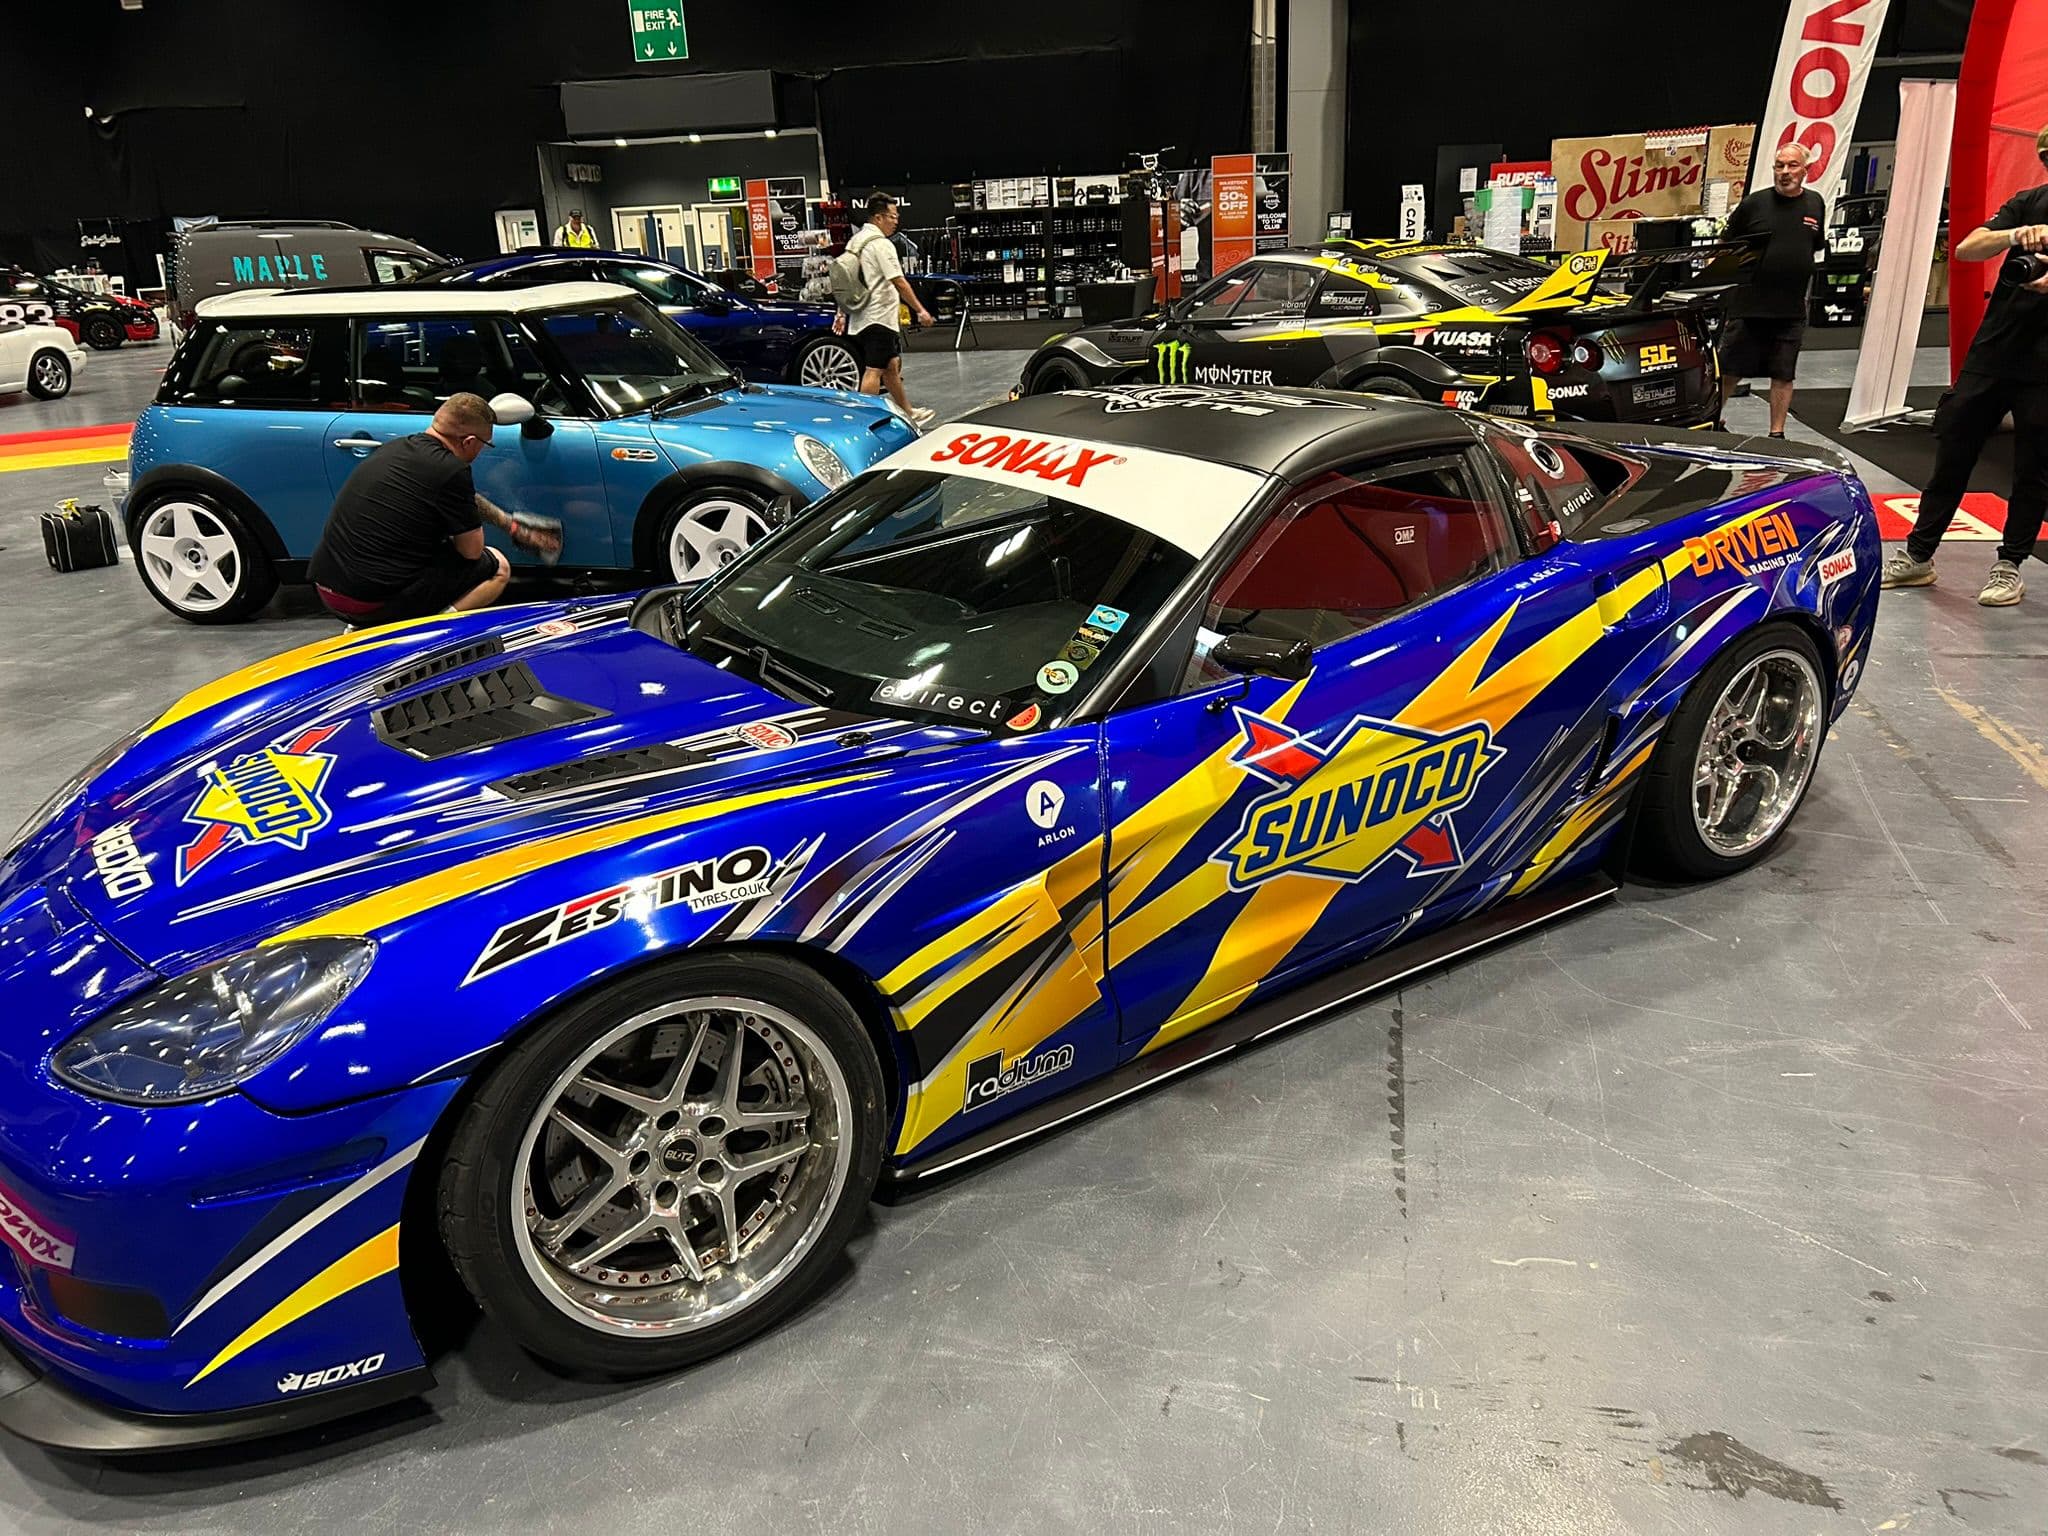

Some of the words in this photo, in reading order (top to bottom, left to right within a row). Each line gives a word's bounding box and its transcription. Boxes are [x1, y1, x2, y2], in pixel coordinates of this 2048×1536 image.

[644, 9, 665, 20] FIRE
[645, 20, 666, 31] EXIT
[1219, 191, 1248, 201] 50%
[1564, 148, 1702, 222] Slim's
[752, 213, 767, 222] 50%
[1219, 201, 1248, 211] OFF
[752, 222, 768, 231] OFF
[1406, 208, 1416, 239] CAR
[775, 233, 799, 241] WELCO
[233, 254, 328, 284] MAPLE
[0, 304, 56, 328] 83
[1281, 301, 1306, 309] vibrant
[1432, 331, 1492, 346] YUASA
[1548, 384, 1590, 400] SONAX
[930, 433, 1119, 488] SONAX
[1562, 487, 1595, 517] edirect
[1394, 528, 1415, 543] OMP
[1683, 512, 1800, 578] DRIVEN
[1750, 557, 1786, 576] RACING
[1787, 552, 1803, 565] OIL
[1822, 555, 1854, 580] SONAX
[743, 722, 790, 747] BMC
[221, 751, 314, 834] SUNOCO
[1244, 738, 1479, 874] SUNOCO
[1038, 825, 1076, 848] ARLON
[91, 832, 154, 900] BOXO
[691, 880, 766, 912] TYRES.CO.UK
[301, 1353, 386, 1391] BOXO
